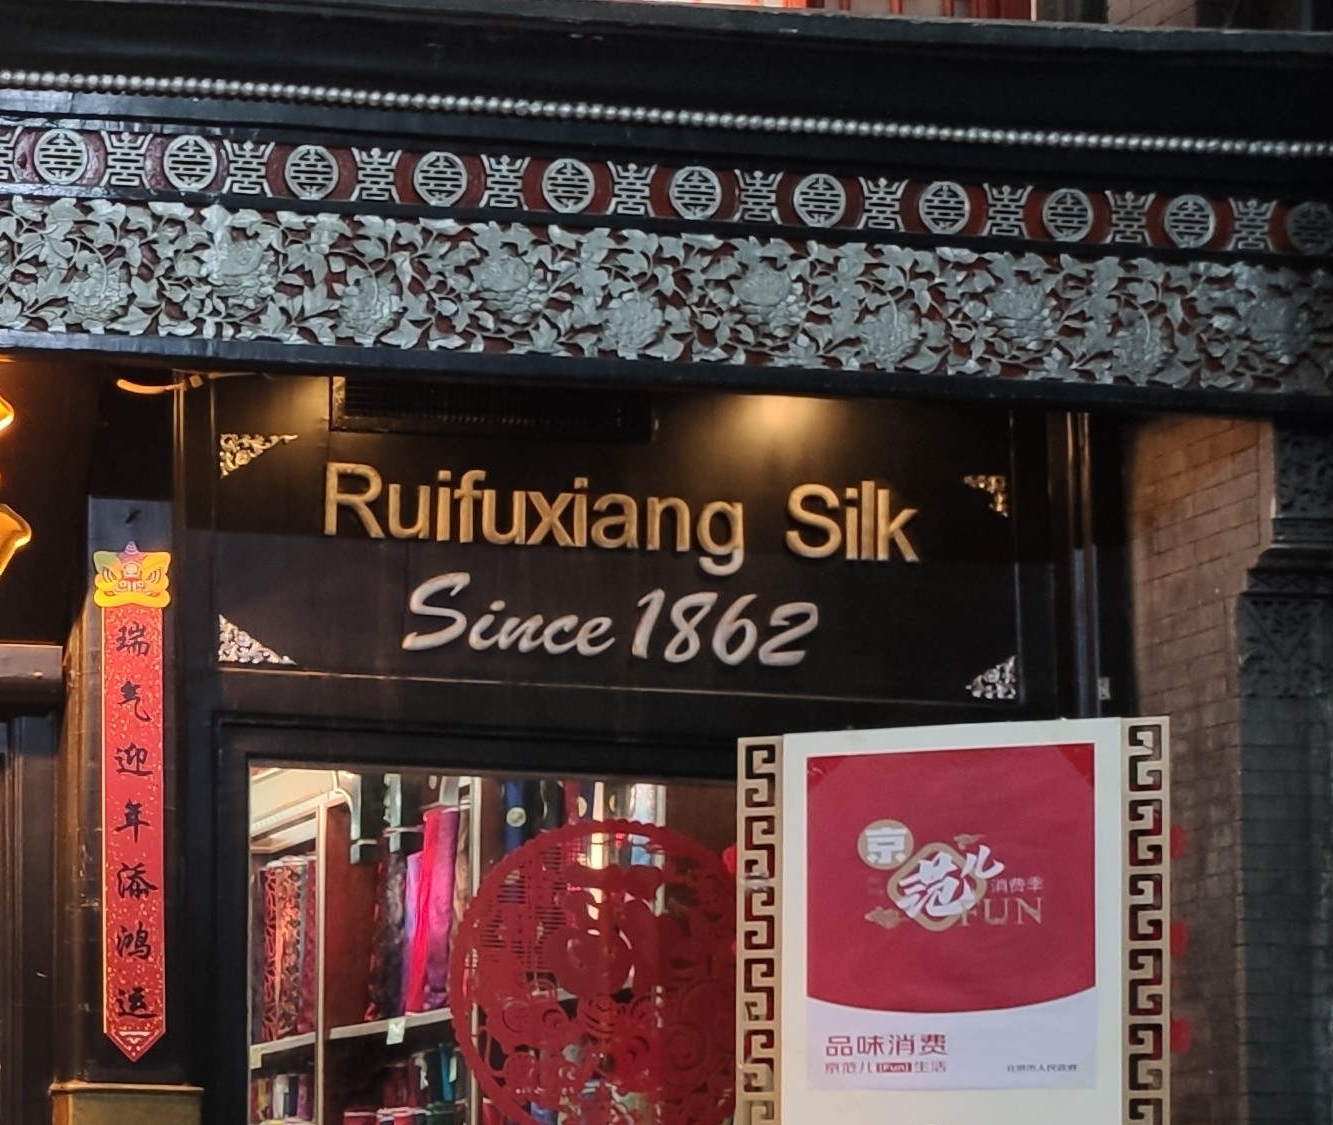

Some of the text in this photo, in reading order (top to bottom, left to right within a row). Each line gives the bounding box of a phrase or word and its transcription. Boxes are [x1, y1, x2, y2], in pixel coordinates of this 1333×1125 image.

[323, 461, 919, 577] Ruifuxiang Silk
[401, 572, 820, 666] Since 1862
[825, 1033, 949, 1057] 品味消费
